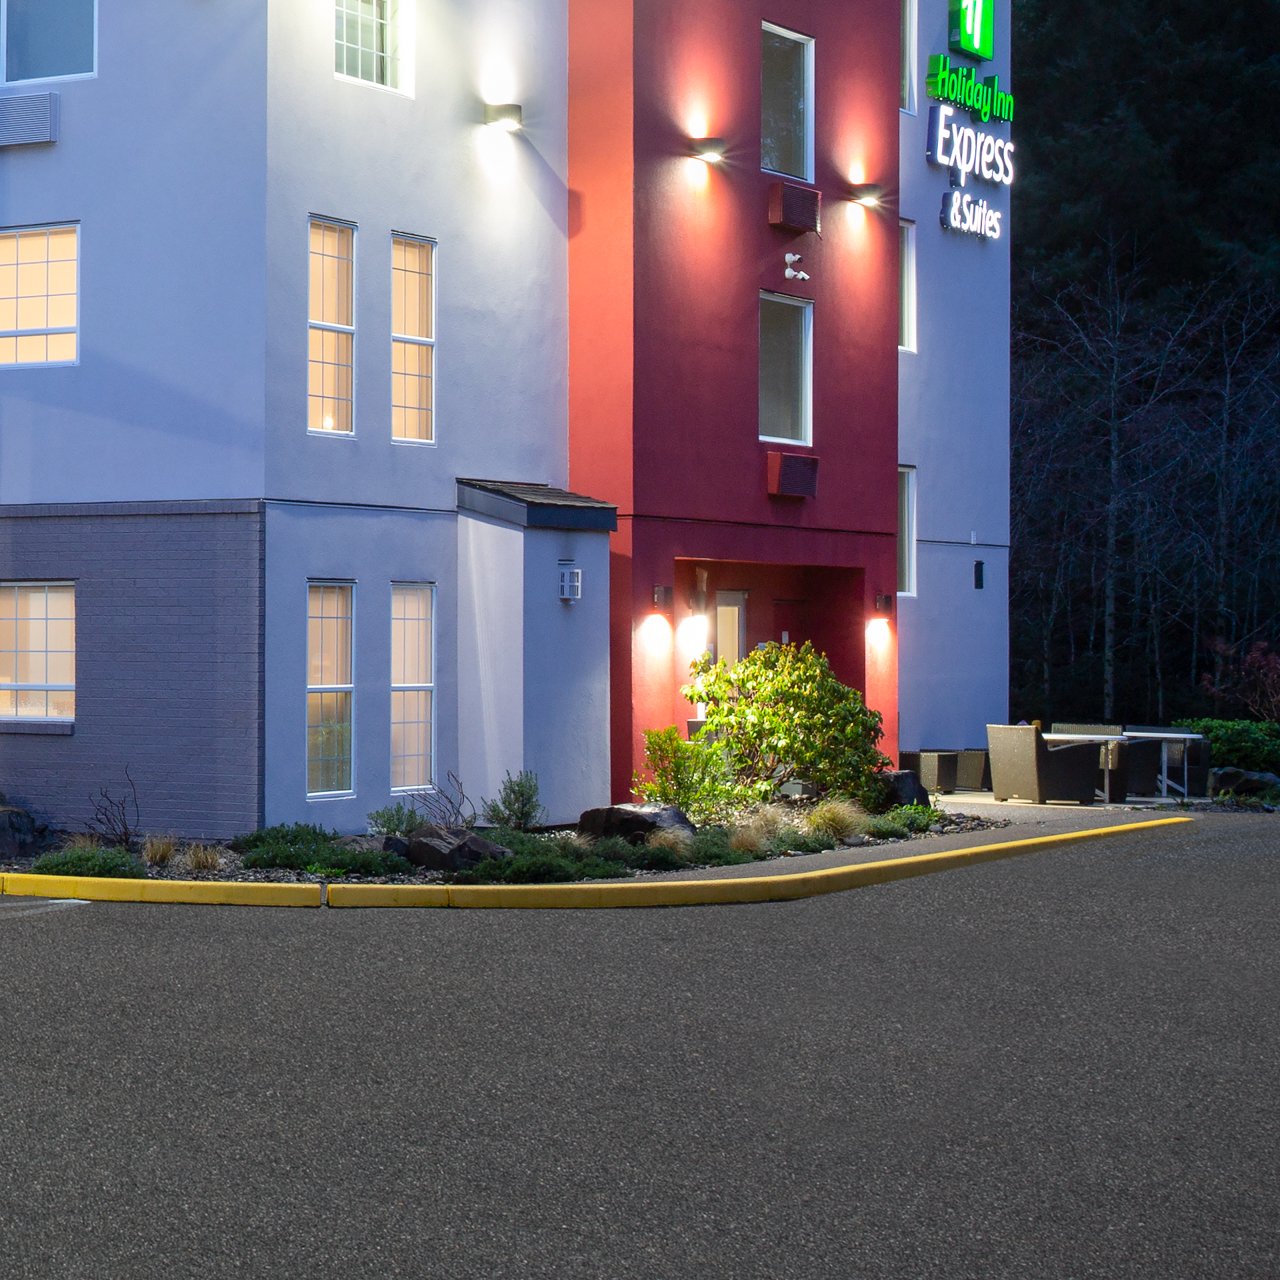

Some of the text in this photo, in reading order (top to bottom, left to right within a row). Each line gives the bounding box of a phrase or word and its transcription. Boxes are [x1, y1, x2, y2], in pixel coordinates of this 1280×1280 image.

[938, 53, 1015, 123] Holiday Inn
[937, 104, 1015, 187] Express
